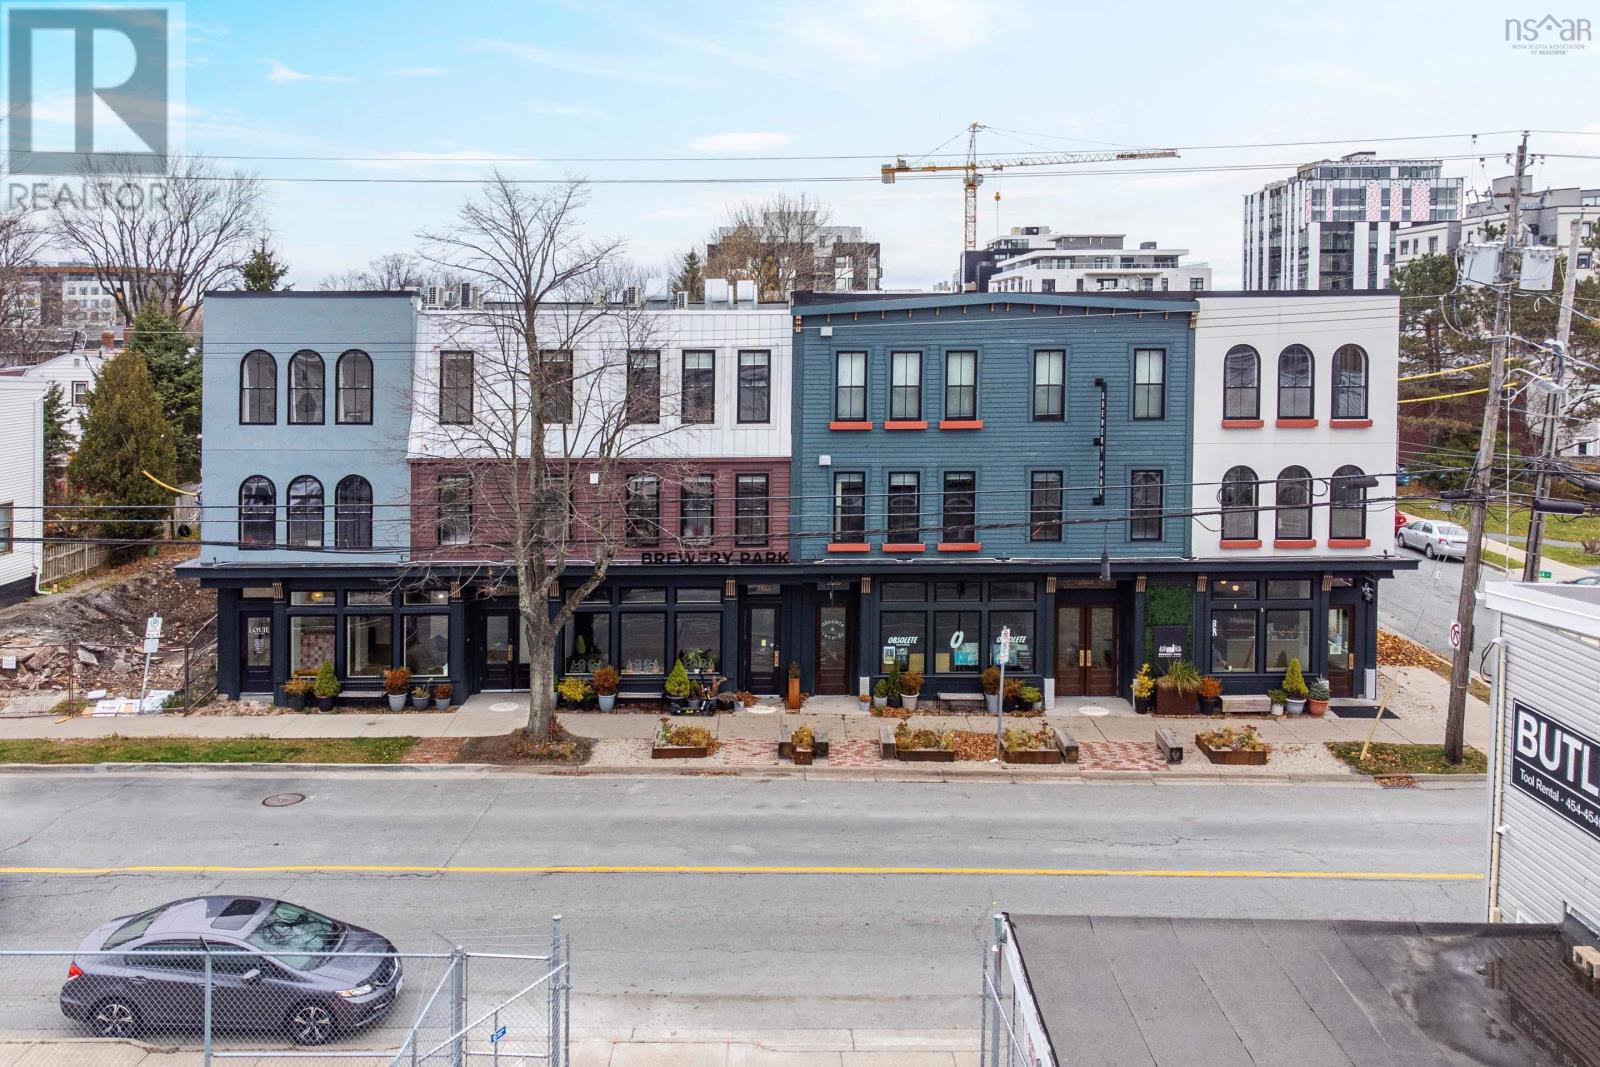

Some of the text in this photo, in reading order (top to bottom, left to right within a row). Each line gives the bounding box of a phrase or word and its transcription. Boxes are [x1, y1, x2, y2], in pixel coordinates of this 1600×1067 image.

[641, 552, 790, 565] BREWERY PARK
[887, 636, 919, 644] OBSOLETE
[1517, 709, 1600, 798] BUTL
[1520, 768, 1600, 828] Tool Rental 454-454
